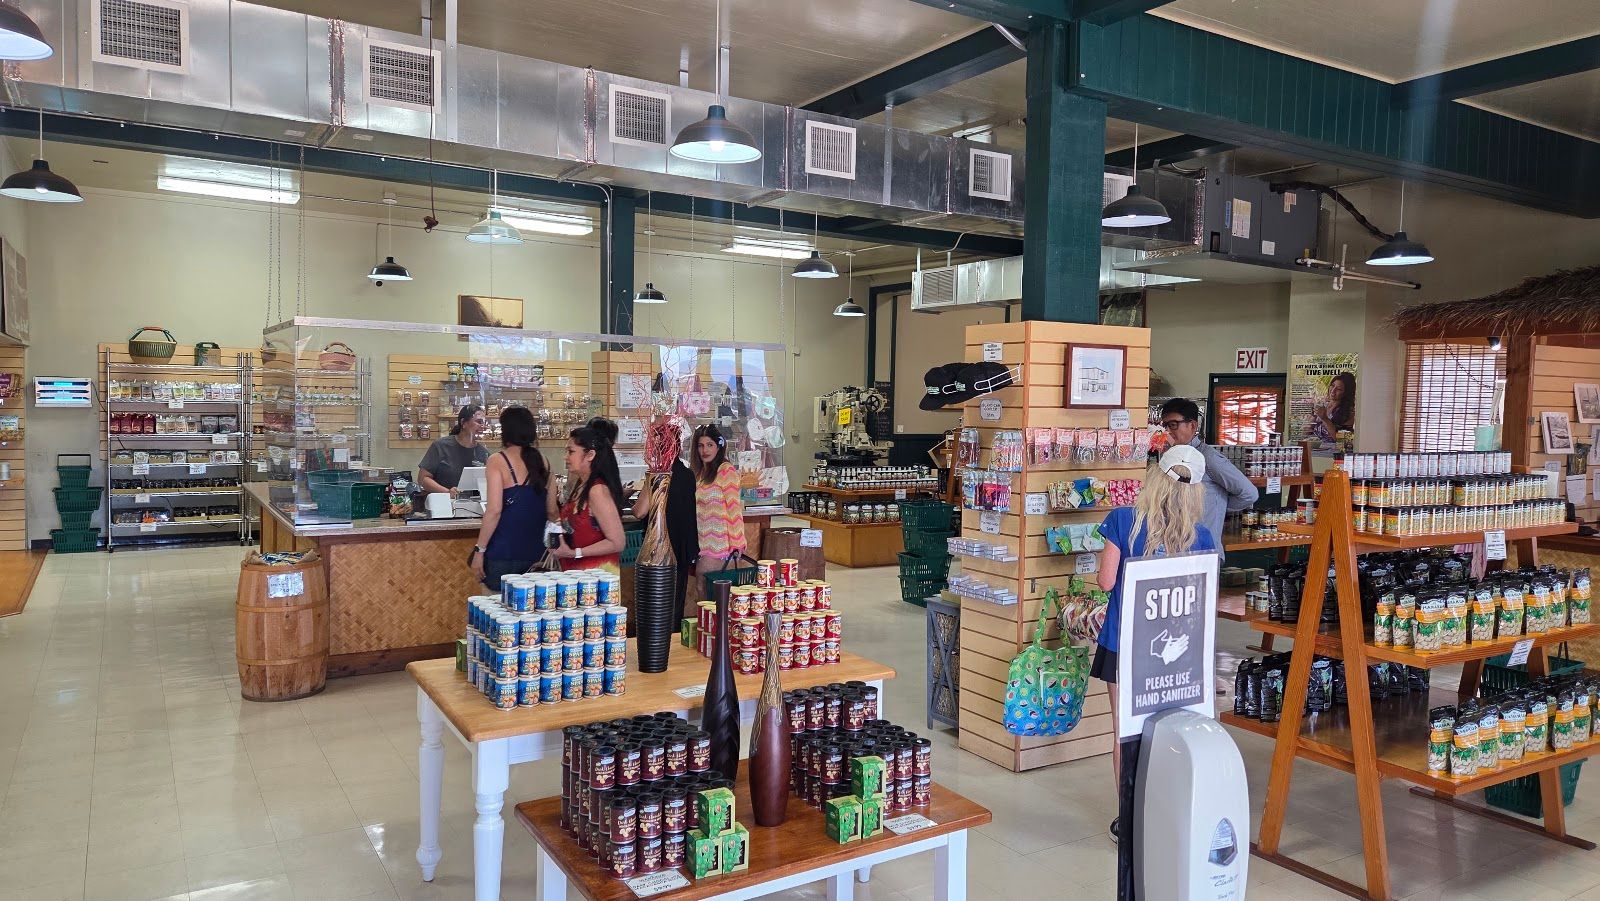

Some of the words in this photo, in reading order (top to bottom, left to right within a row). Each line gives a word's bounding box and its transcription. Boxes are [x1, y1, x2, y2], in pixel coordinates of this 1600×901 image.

[1237, 350, 1267, 369] EXIT
[1145, 585, 1196, 621] STOP
[1145, 674, 1174, 691] PLEASE
[1175, 671, 1191, 685] USE
[1136, 692, 1160, 708] HAND
[1161, 684, 1201, 703] SANITIZER
